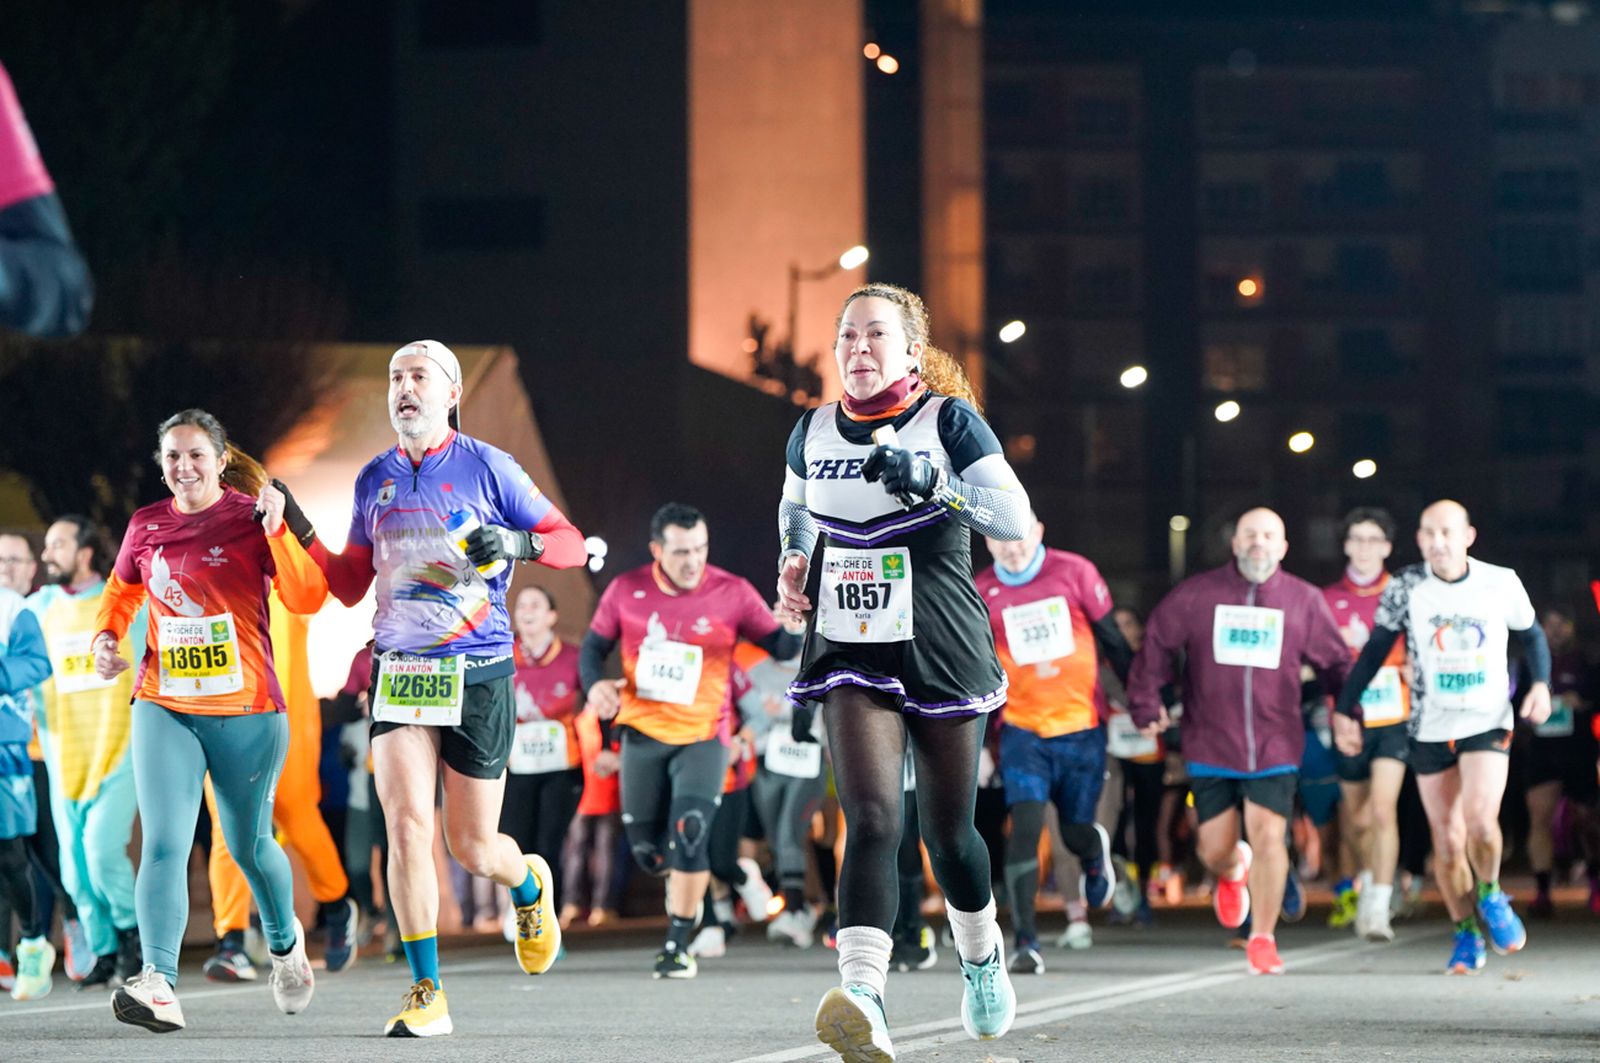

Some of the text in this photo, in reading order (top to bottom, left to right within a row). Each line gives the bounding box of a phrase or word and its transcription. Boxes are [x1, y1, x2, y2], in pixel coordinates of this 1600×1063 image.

[862, 560, 873, 569] DE
[164, 586, 183, 607] 43
[834, 583, 892, 610] 1857
[194, 627, 204, 635] DE
[168, 644, 228, 670] 13615
[388, 674, 452, 698] 12635
